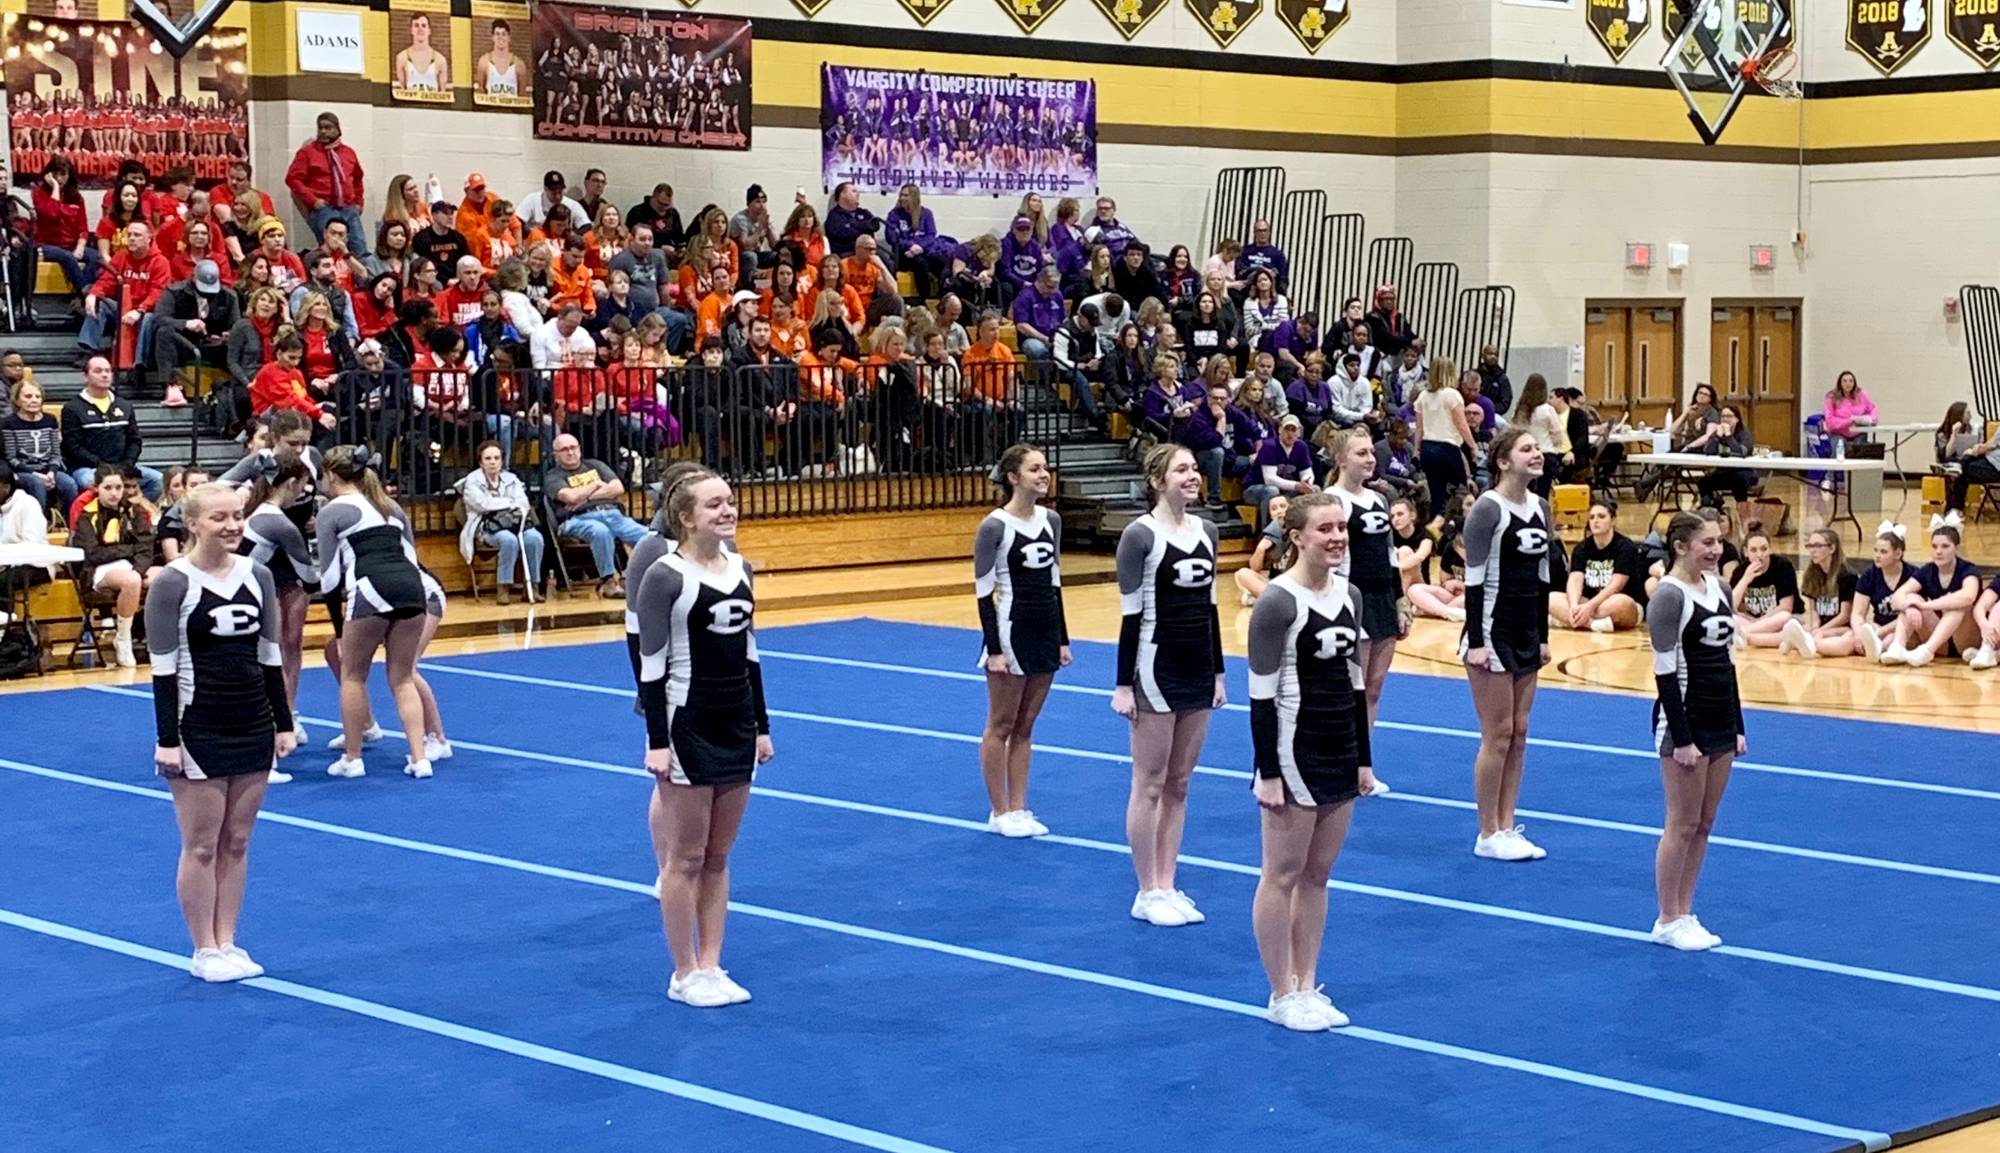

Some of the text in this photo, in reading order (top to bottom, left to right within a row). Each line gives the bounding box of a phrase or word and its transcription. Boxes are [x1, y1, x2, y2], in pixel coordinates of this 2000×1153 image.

[1857, 2, 1899, 24] 2018
[1954, 0, 1999, 16] 2018
[303, 34, 359, 49] ADAMS
[844, 69, 1076, 99] VARSITY COMPETITIVE CHEER
[537, 121, 748, 148] COMPETITIVE CHEER
[849, 167, 1070, 192] WOODHAVEN WARRIORS
[1515, 527, 1548, 554] E
[1020, 541, 1055, 569] E
[1172, 557, 1214, 588] E
[207, 603, 262, 636] E
[706, 598, 754, 635] E
[1313, 625, 1357, 659] E
[1700, 615, 1736, 647] E
